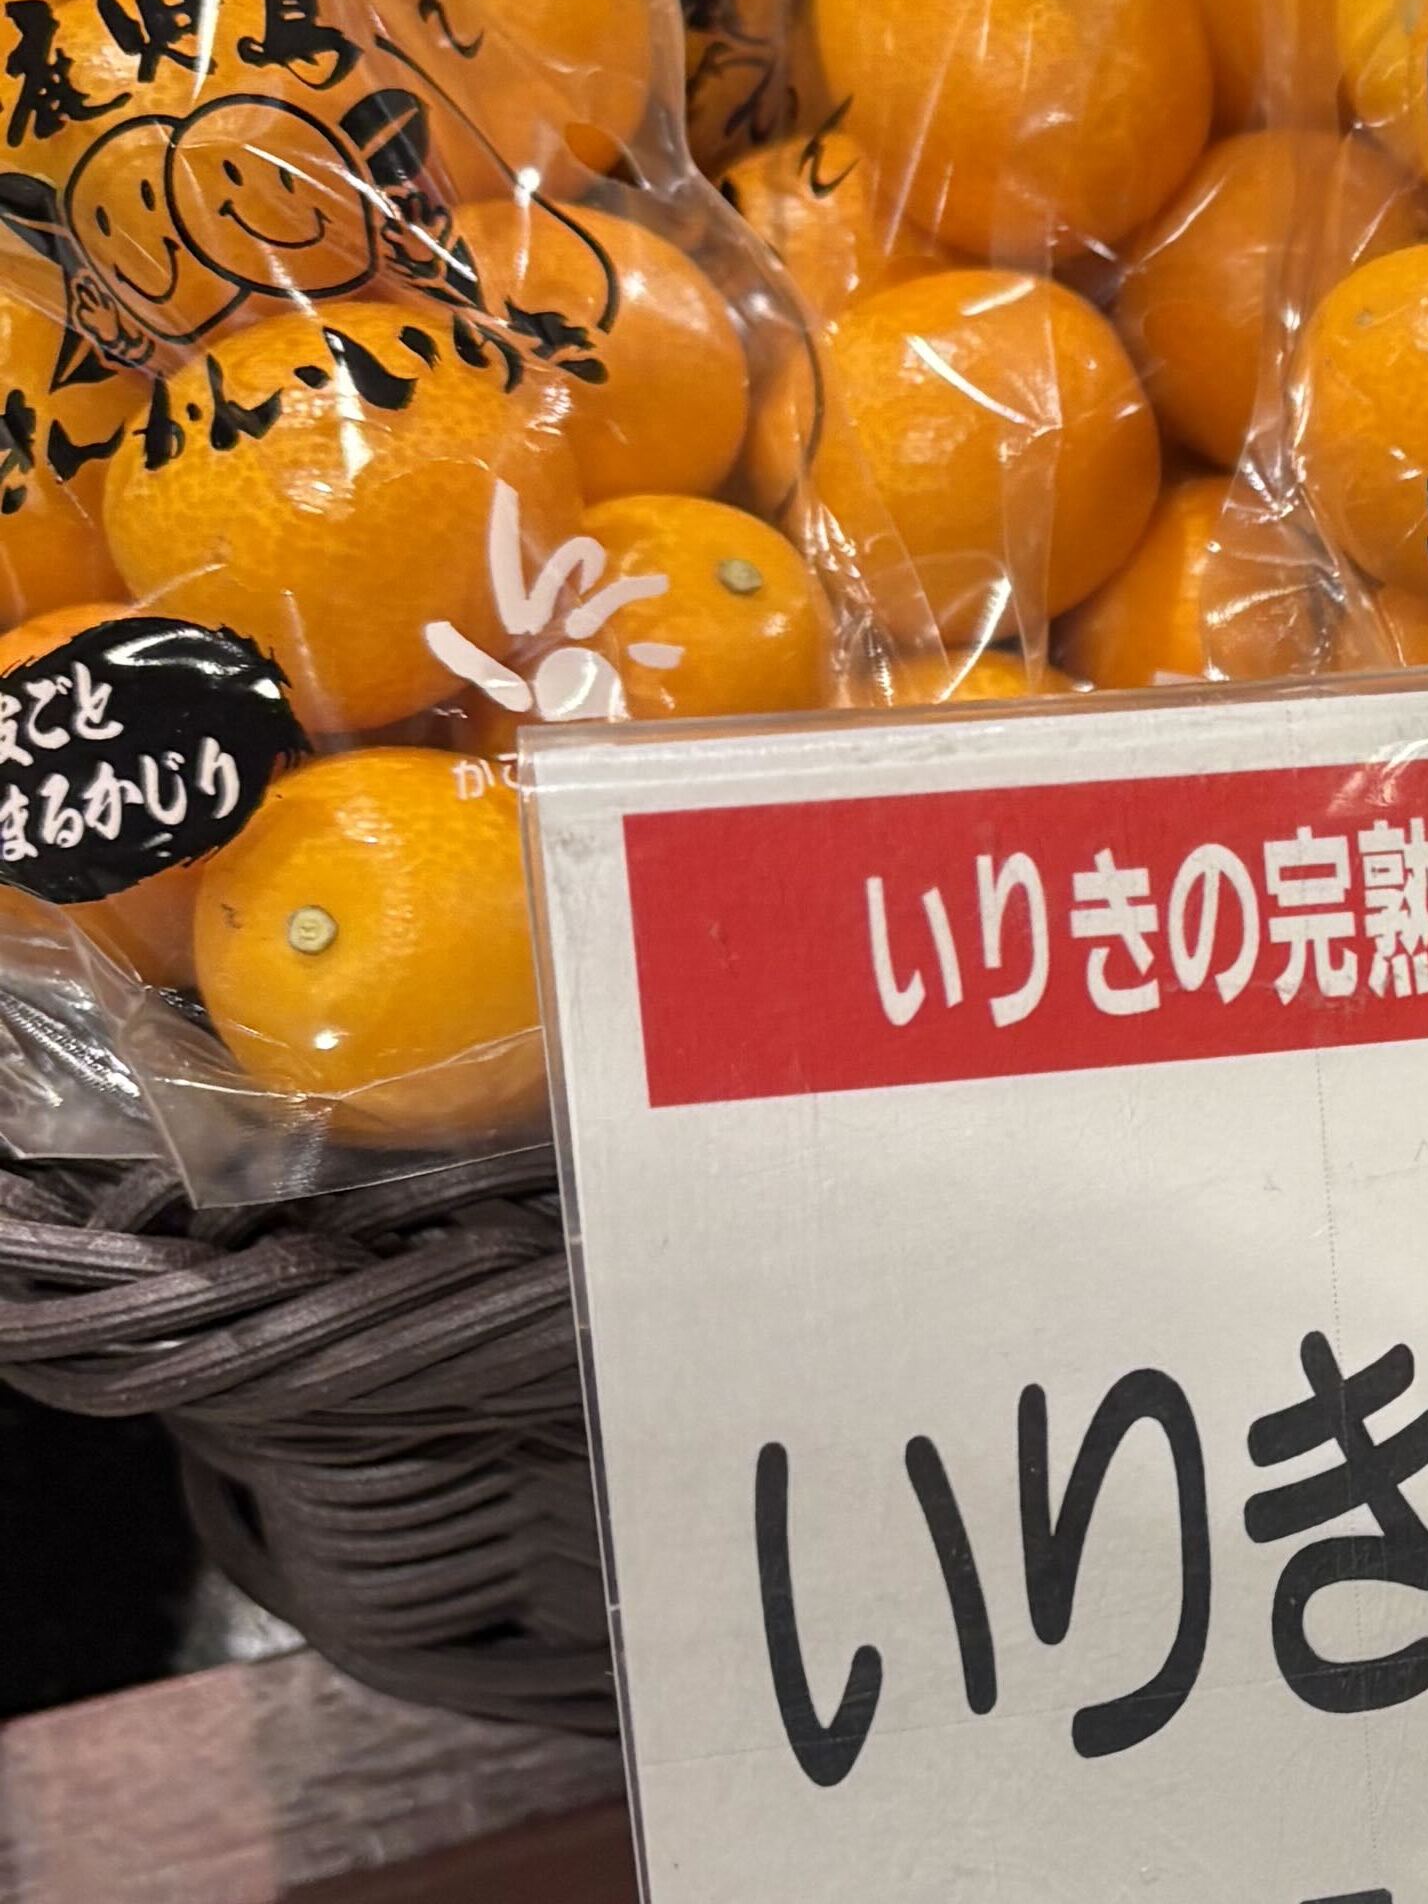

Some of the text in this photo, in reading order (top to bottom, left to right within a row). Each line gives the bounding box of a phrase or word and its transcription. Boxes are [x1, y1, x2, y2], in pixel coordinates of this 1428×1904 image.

[0, 736, 240, 863] まるかじり
